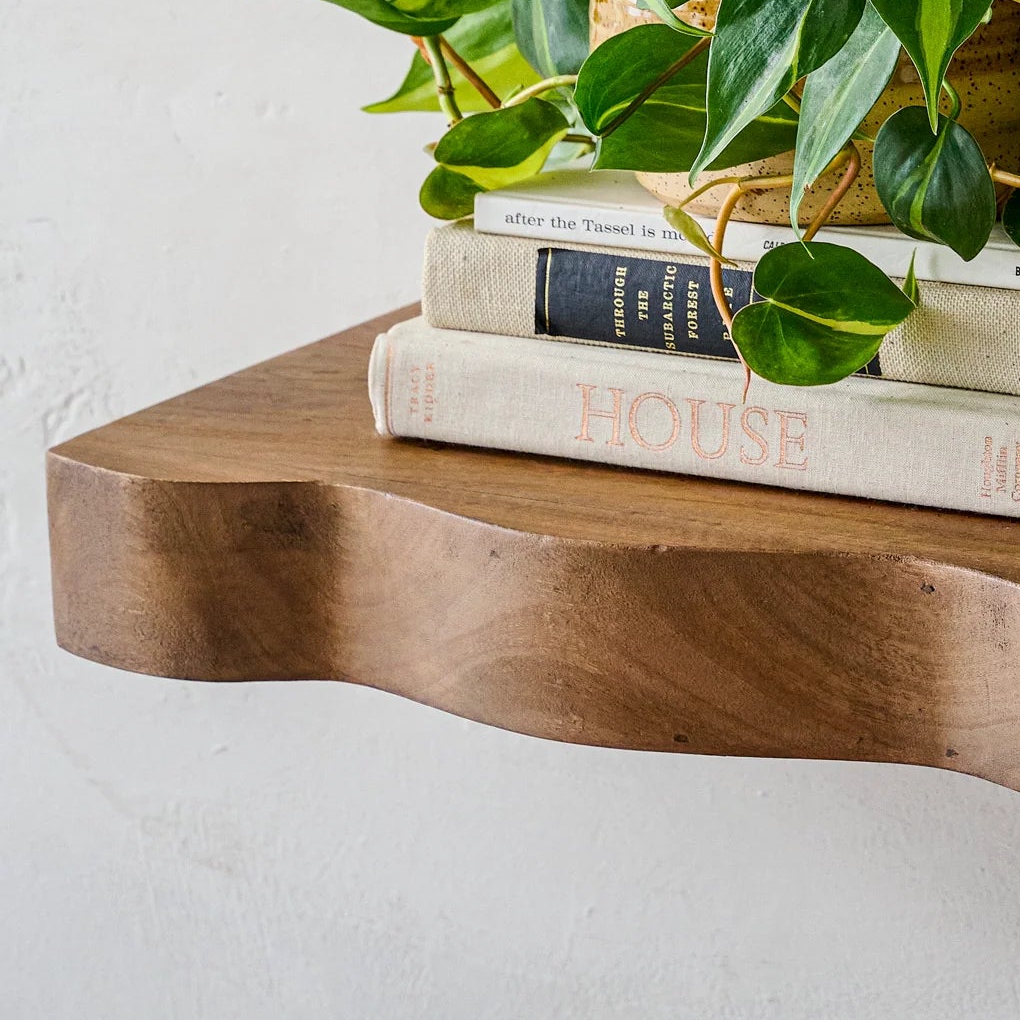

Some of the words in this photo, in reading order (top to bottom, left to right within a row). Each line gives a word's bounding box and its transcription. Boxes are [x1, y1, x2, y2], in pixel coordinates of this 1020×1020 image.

[504, 212, 544, 228] after
[550, 216, 576, 231] the
[582, 219, 635, 236] Tassel
[641, 224, 656, 238] is
[614, 266, 628, 338] THROUGH
[638, 289, 649, 321] THE
[666, 265, 678, 350] SUBARCTIC
[687, 281, 700, 340] FOREST
[576, 383, 809, 471] HOUSE
